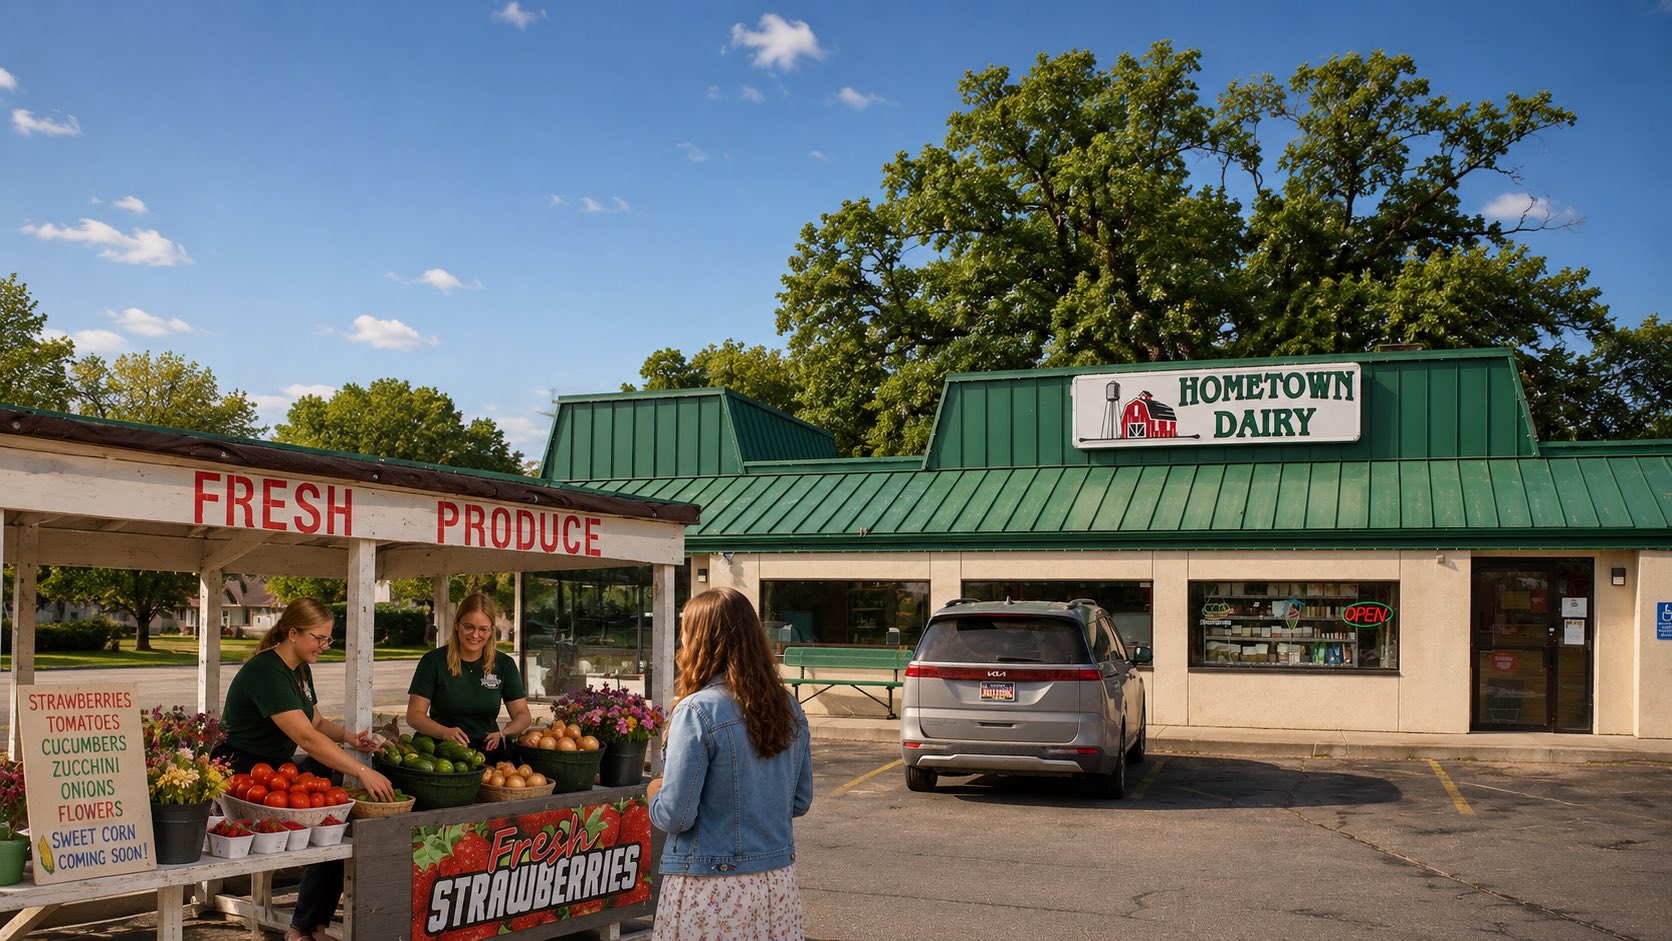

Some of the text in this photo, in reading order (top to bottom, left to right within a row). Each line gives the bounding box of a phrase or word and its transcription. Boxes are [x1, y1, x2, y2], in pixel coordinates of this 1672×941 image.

[1178, 371, 1354, 407] HOMETOWN
[1213, 407, 1317, 438] DAIRY
[194, 470, 601, 556] FRESH PRODUCE
[1343, 606, 1388, 623] OPEN
[28, 691, 132, 711] STRAWBERRIES
[46, 714, 120, 733] TOMATOES
[41, 735, 127, 755] CUCUMBERS
[52, 757, 120, 778] ZUCCHINI
[58, 801, 123, 823] FLOWERS
[52, 824, 136, 849] SWEET CORN
[487, 812, 600, 874] Fresh
[58, 842, 148, 870] COMING SOON!
[427, 844, 641, 933] STRAWBERRIES
